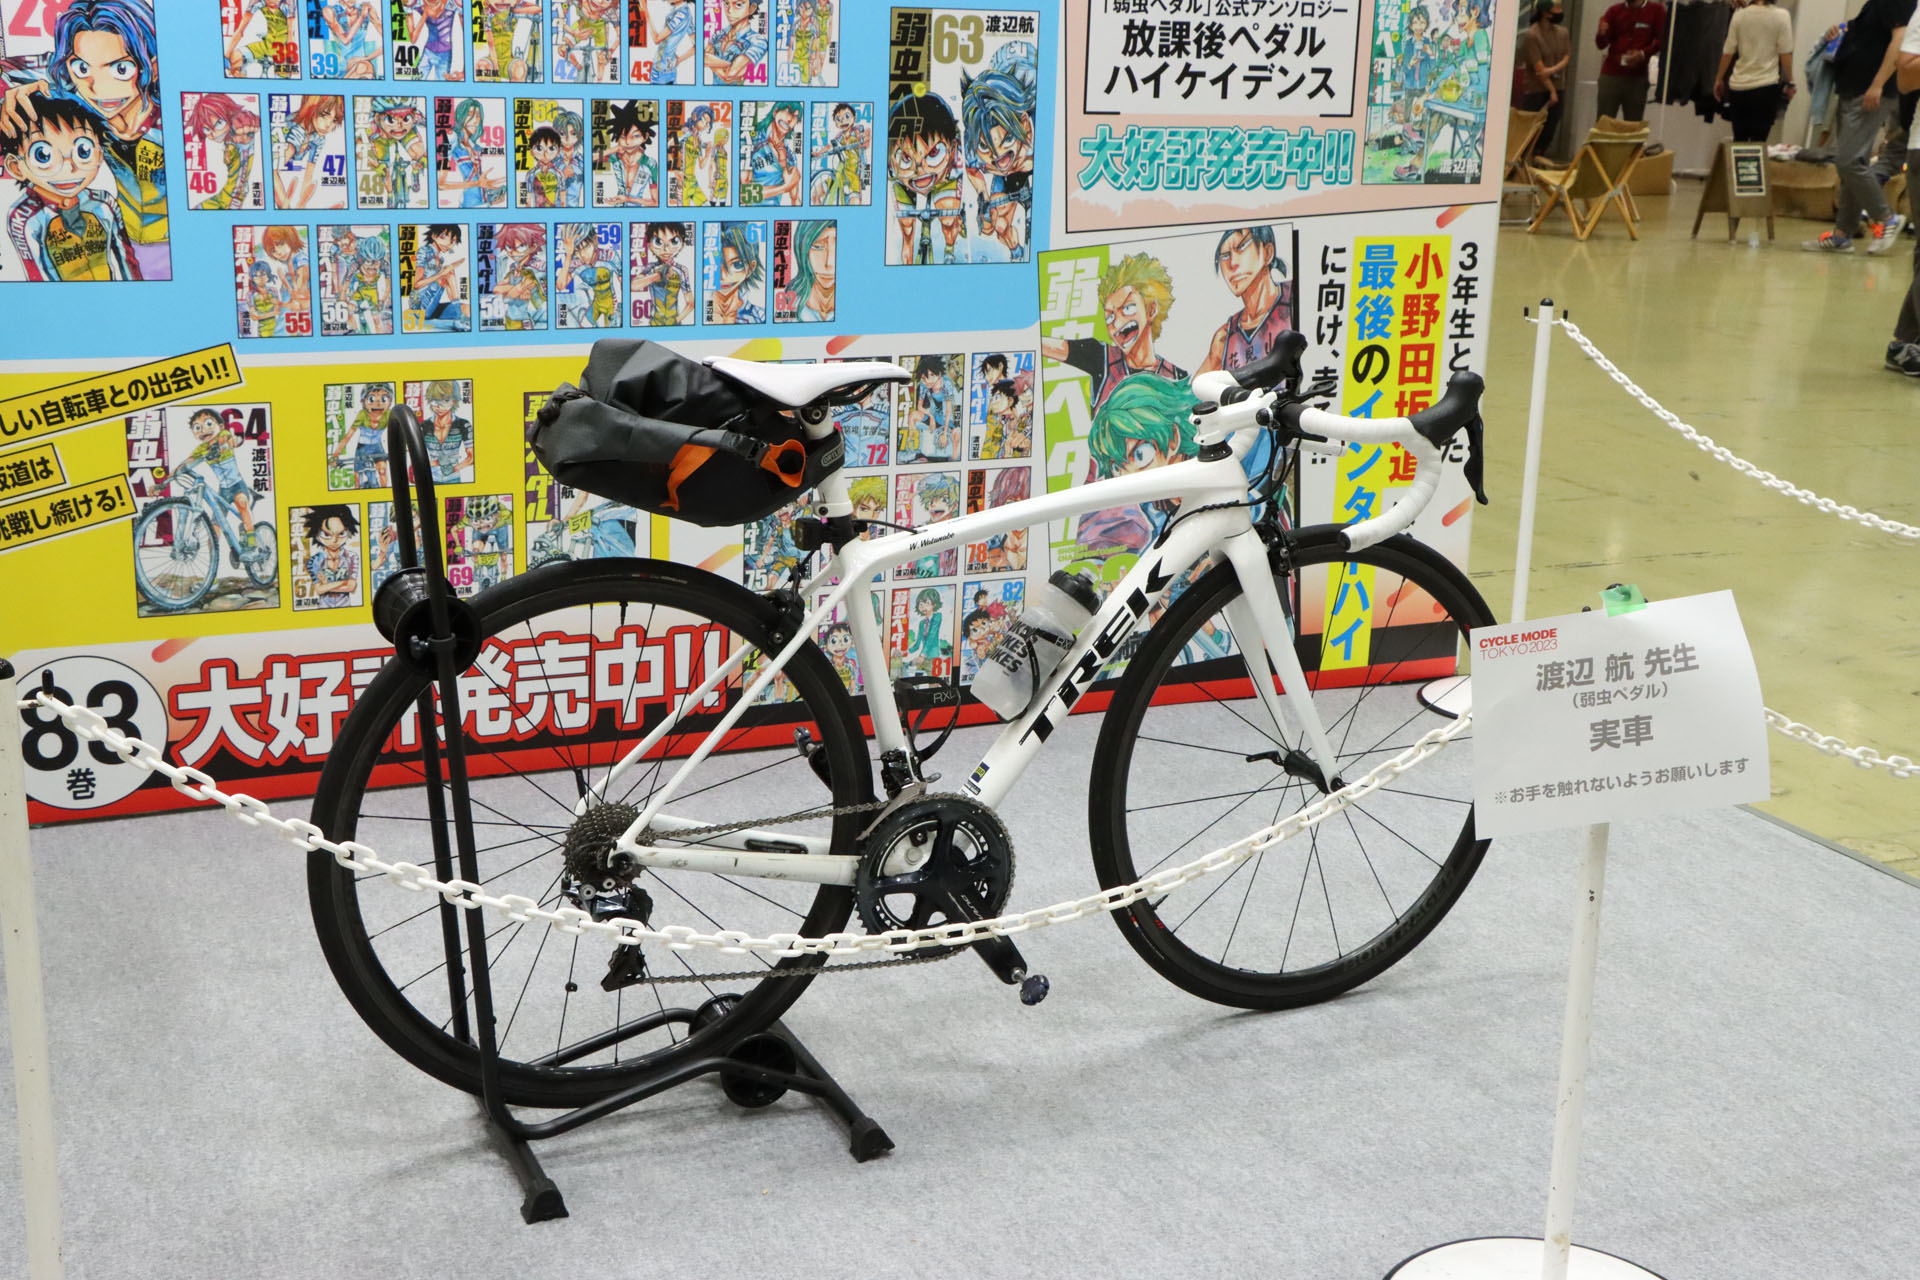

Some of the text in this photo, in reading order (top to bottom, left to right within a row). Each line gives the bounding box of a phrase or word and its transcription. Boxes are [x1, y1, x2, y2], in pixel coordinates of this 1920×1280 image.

[986, 15, 1034, 33] 渡辺航
[933, 15, 984, 64] 63
[1122, 19, 1326, 59] 放課後ペダル
[272, 42, 298, 64] 38
[395, 46, 419, 66] 40
[312, 53, 338, 75] 39
[555, 59, 577, 79] 42
[631, 61, 653, 82] 43
[744, 64, 767, 83] 44
[778, 62, 800, 84] 45
[1104, 61, 1335, 100] ハイケイデンス
[533, 100, 558, 122] 50
[638, 101, 658, 123] 51
[710, 103, 731, 123] 52
[855, 103, 872, 123] 54
[480, 126, 504, 147] 49
[323, 155, 344, 176] 47
[1077, 124, 1356, 191] 大好評発売中!!
[190, 172, 217, 194] 46
[359, 174, 384, 195] 48
[741, 184, 763, 204] 53
[597, 225, 621, 244] 59
[746, 223, 766, 243] 61
[322, 301, 348, 322] 56
[632, 300, 651, 319] 60
[775, 291, 797, 311] 62
[285, 312, 311, 333] 55
[403, 310, 425, 331] 57
[1014, 354, 1033, 373] 74
[221, 408, 270, 447] 64
[867, 444, 887, 464] 72
[252, 448, 268, 492] 渡辺航
[330, 468, 355, 488] 65
[571, 516, 588, 533] 57
[968, 544, 987, 563] 78
[450, 567, 472, 587] 69
[745, 569, 767, 589] 75
[1002, 581, 1023, 601] 82
[1480, 628, 1557, 649] CYCLE MODE
[1019, 557, 1175, 745] TREK
[931, 657, 951, 677] 81
[1536, 643, 1699, 691] 渡辺 航 先生
[20, 680, 143, 771] 83
[1589, 715, 1654, 752] 実車
[67, 769, 96, 800] 巻
[1494, 758, 1749, 804] ※お手を触れないようお願いします
